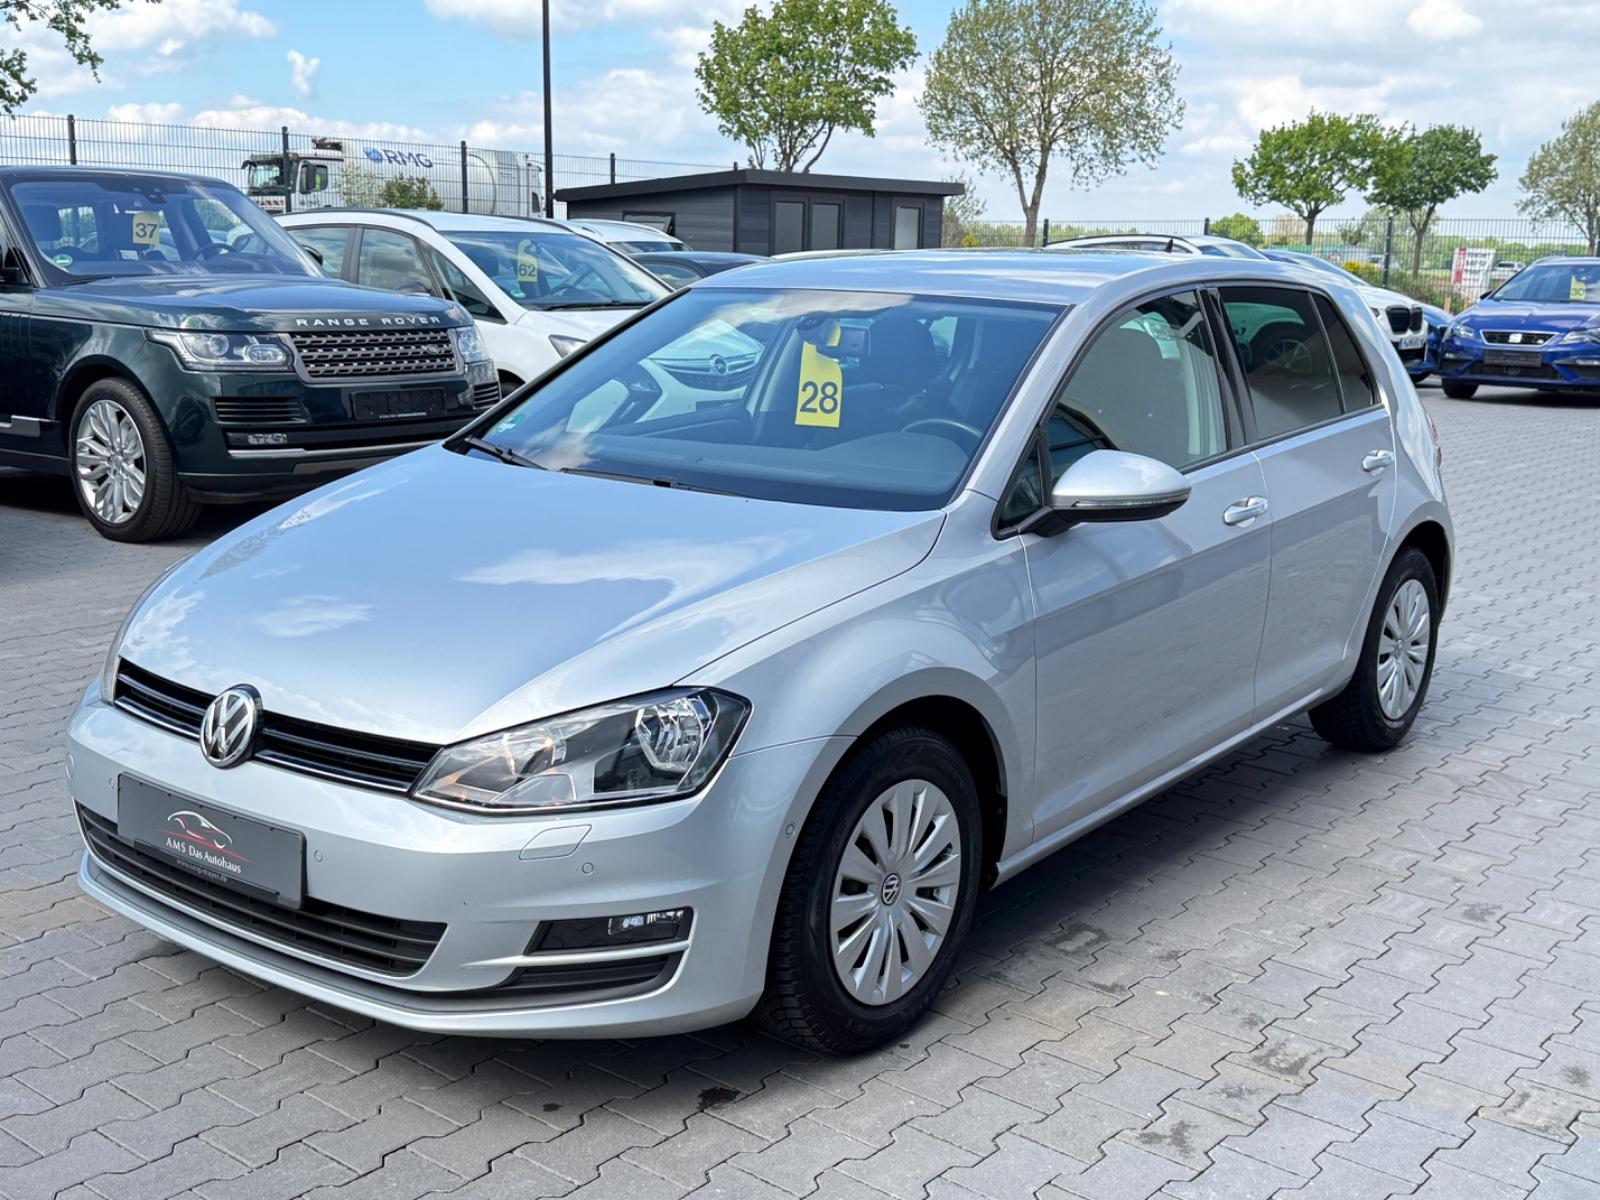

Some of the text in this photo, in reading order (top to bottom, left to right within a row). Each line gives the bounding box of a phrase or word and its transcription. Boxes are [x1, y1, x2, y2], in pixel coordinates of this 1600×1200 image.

[382, 148, 433, 168] RMG
[135, 222, 159, 239] 37
[518, 263, 537, 277] 62
[296, 316, 441, 327] RANGE ROVER
[799, 380, 839, 414] 28
[166, 837, 242, 875] AMS Das Autohaus
